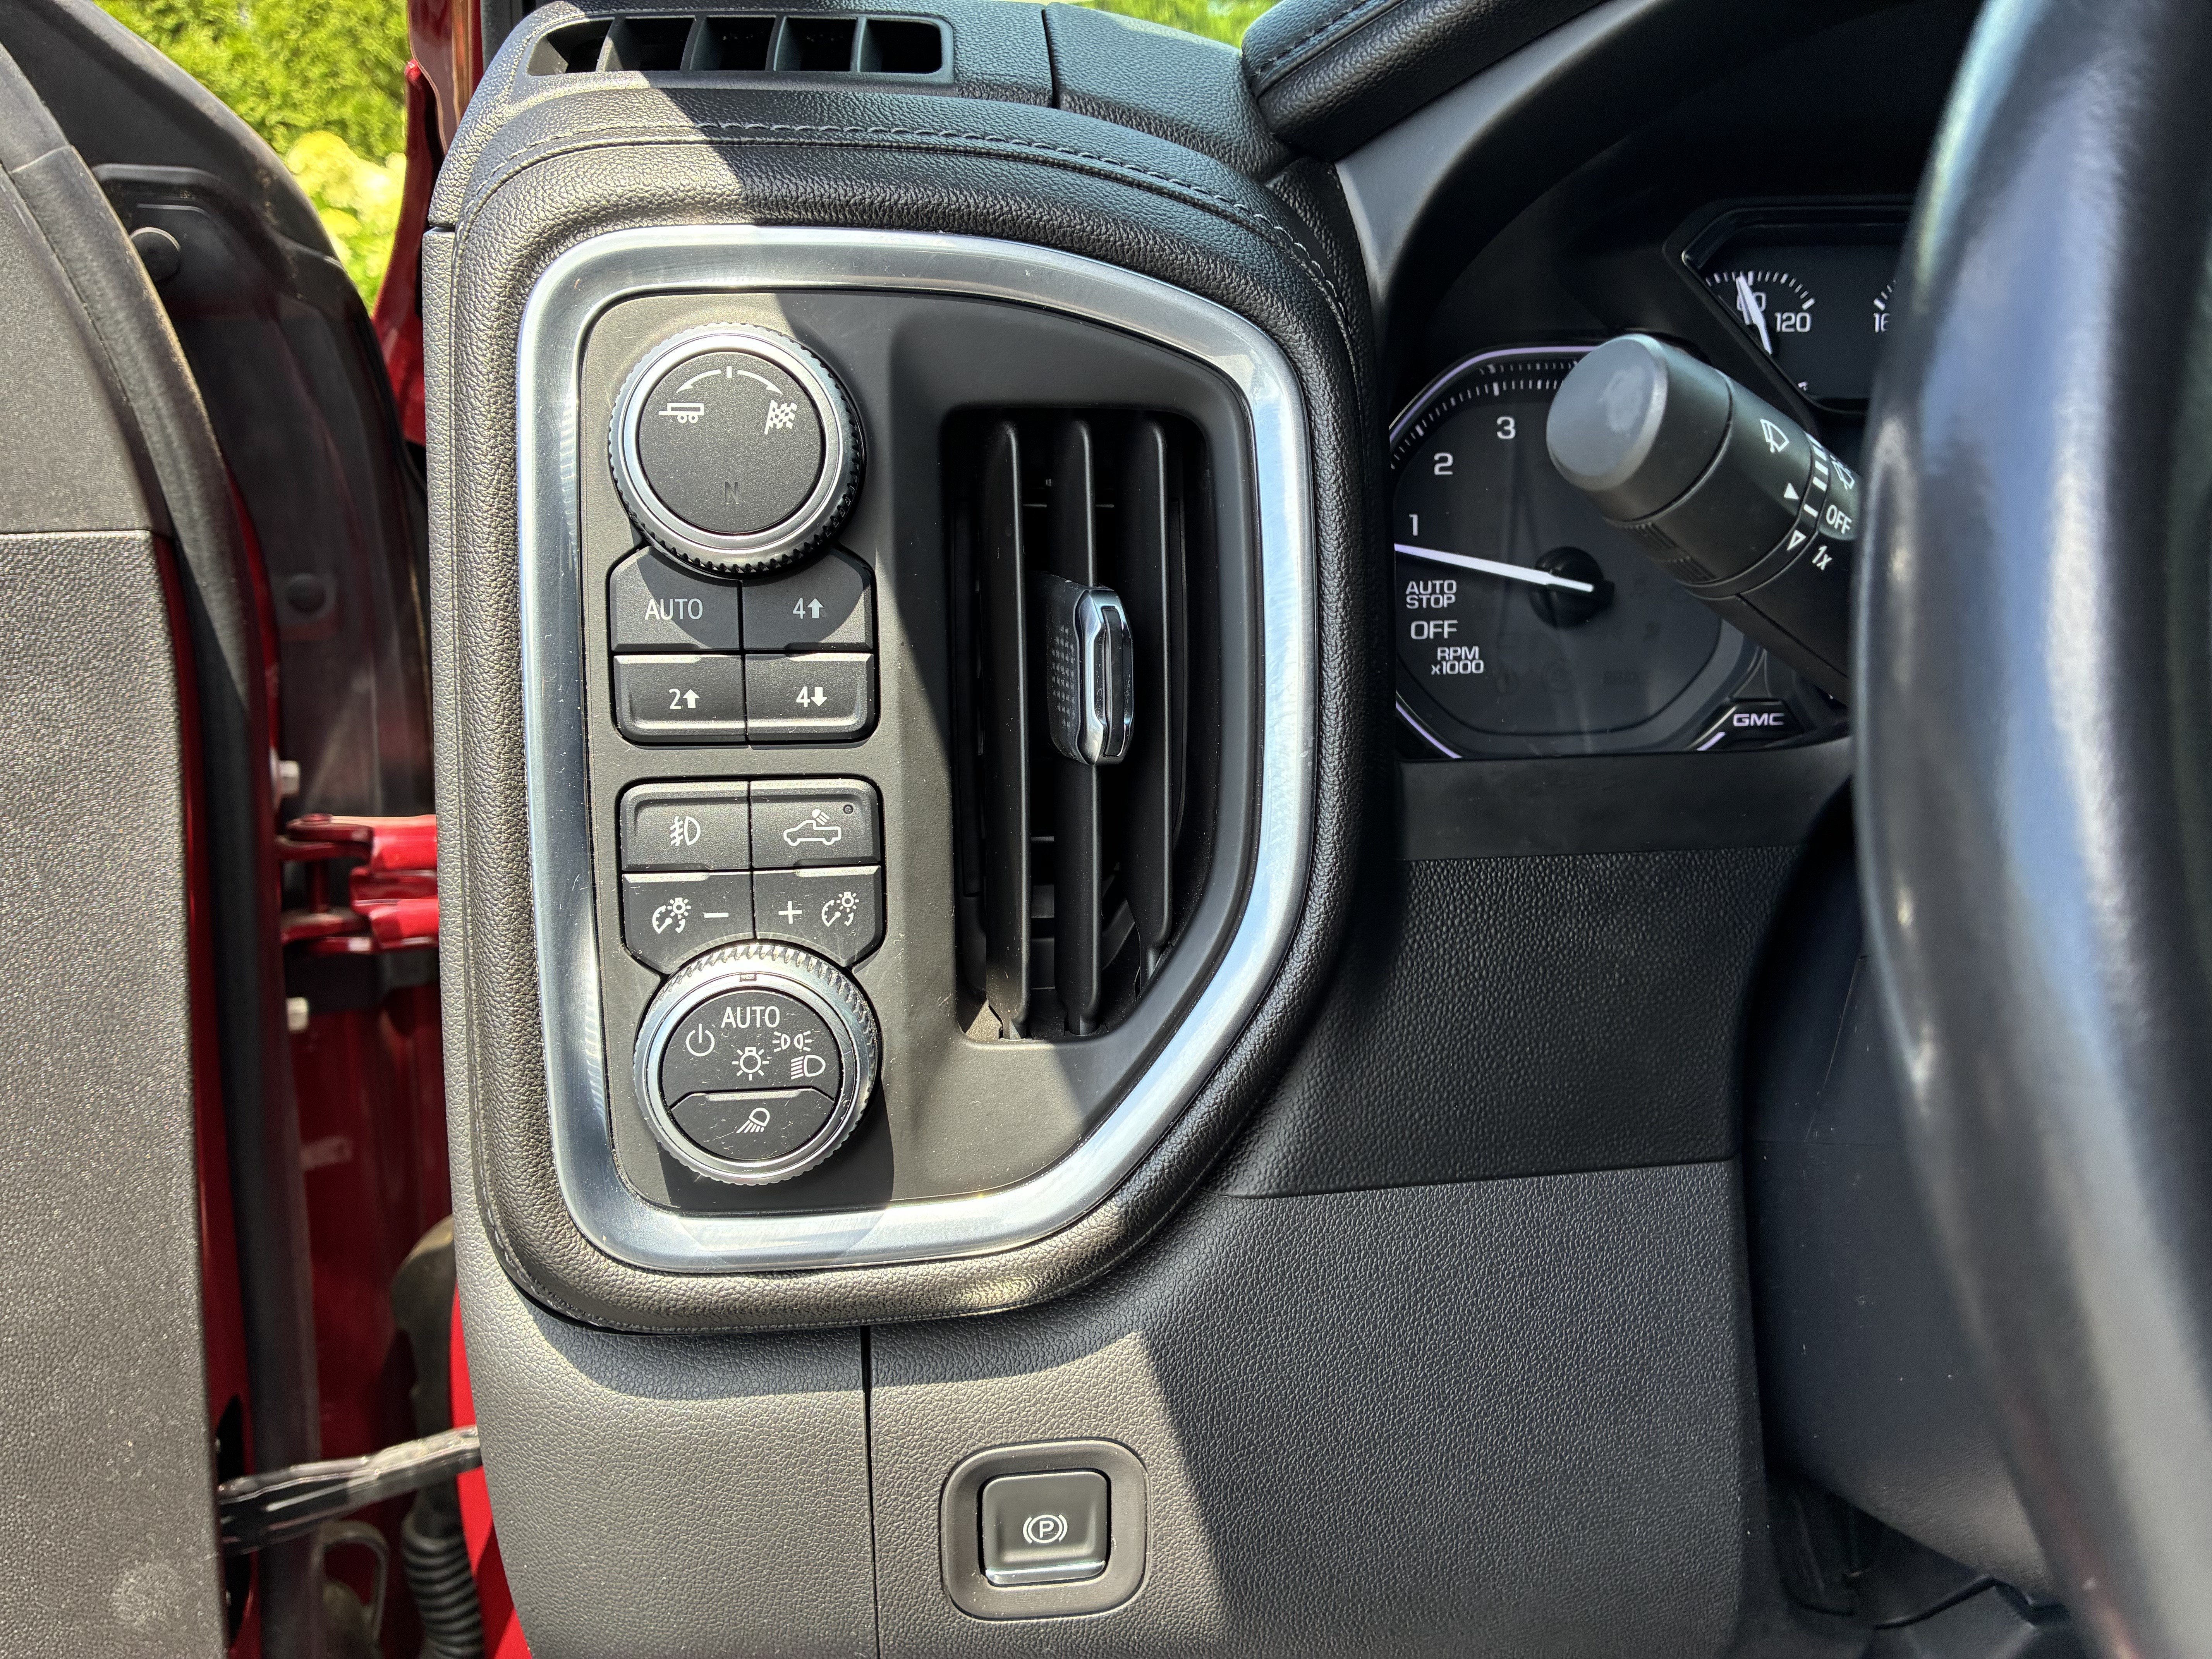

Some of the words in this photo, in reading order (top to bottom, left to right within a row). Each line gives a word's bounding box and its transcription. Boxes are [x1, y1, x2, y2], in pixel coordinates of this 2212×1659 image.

[1775, 313, 1811, 332] 120
[1497, 417, 1516, 439] 3
[1434, 453, 1453, 475] 2
[725, 482, 739, 504] N
[1409, 514, 1418, 536] 1
[1826, 505, 1852, 534] OFF
[1812, 546, 1832, 570] 1x
[1405, 580, 1457, 594] AUTO
[645, 598, 703, 620] AUTO
[1406, 594, 1456, 609] STOP
[1410, 620, 1458, 639] OFF
[1437, 646, 1479, 661] RPM
[1431, 659, 1484, 675] x1000
[1733, 713, 1785, 727] GMC
[721, 1006, 780, 1028] AUTO
